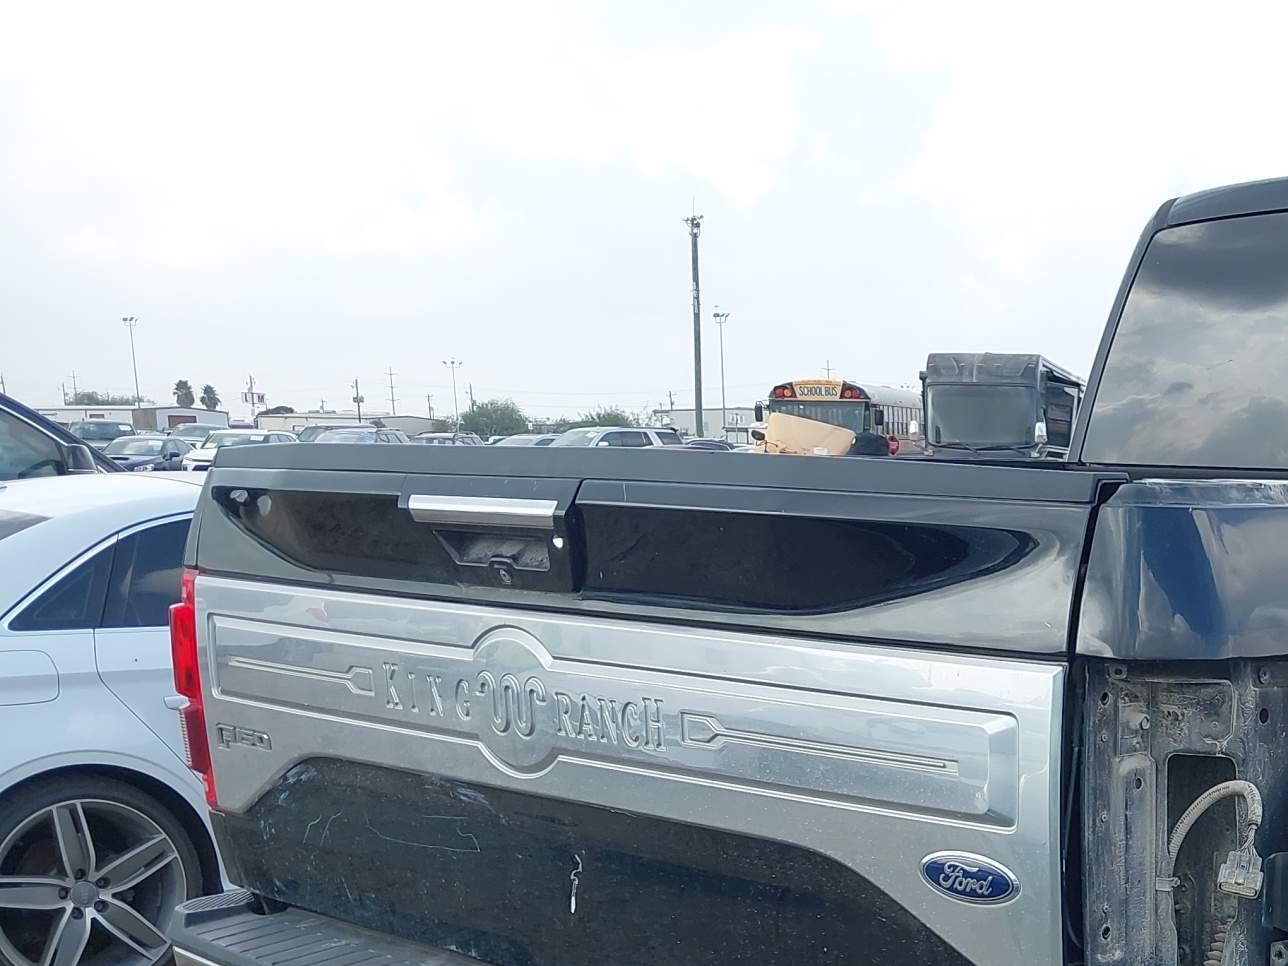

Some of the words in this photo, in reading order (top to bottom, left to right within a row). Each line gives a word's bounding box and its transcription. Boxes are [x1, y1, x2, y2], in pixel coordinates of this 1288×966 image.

[798, 385, 824, 397] SCHOOL
[824, 386, 838, 397] BUS
[382, 662, 472, 721] KING
[553, 690, 667, 752] RANCH
[938, 860, 993, 896] Ford
